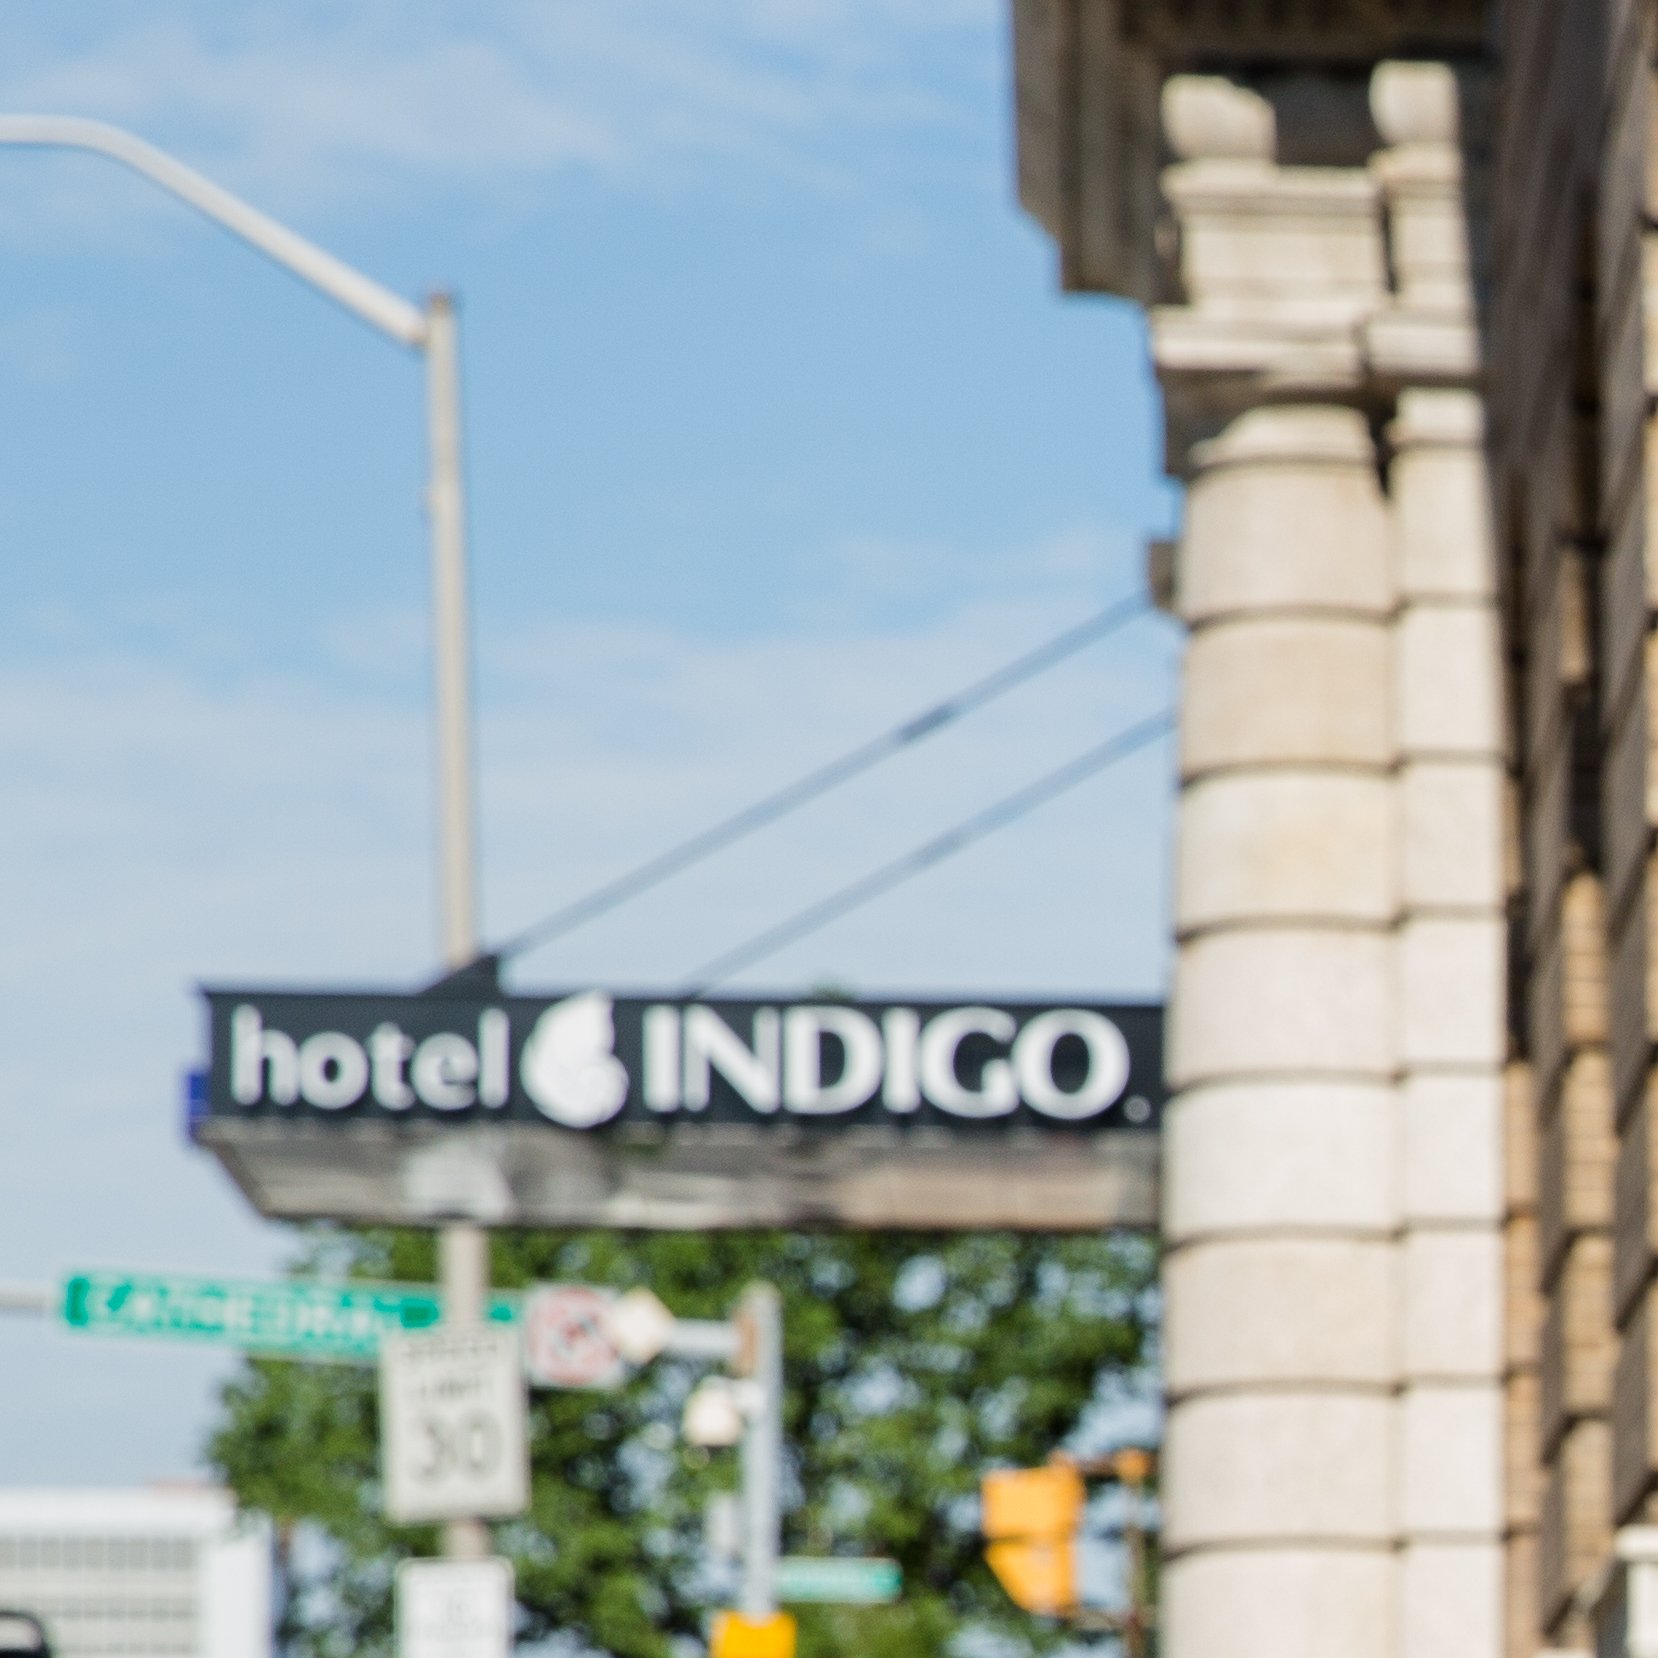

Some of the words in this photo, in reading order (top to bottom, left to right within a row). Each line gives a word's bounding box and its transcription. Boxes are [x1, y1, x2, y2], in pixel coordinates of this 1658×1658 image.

[231, 1004, 510, 1111] hotel
[642, 1003, 1131, 1120] INDIGO
[406, 1412, 503, 1488] 30
